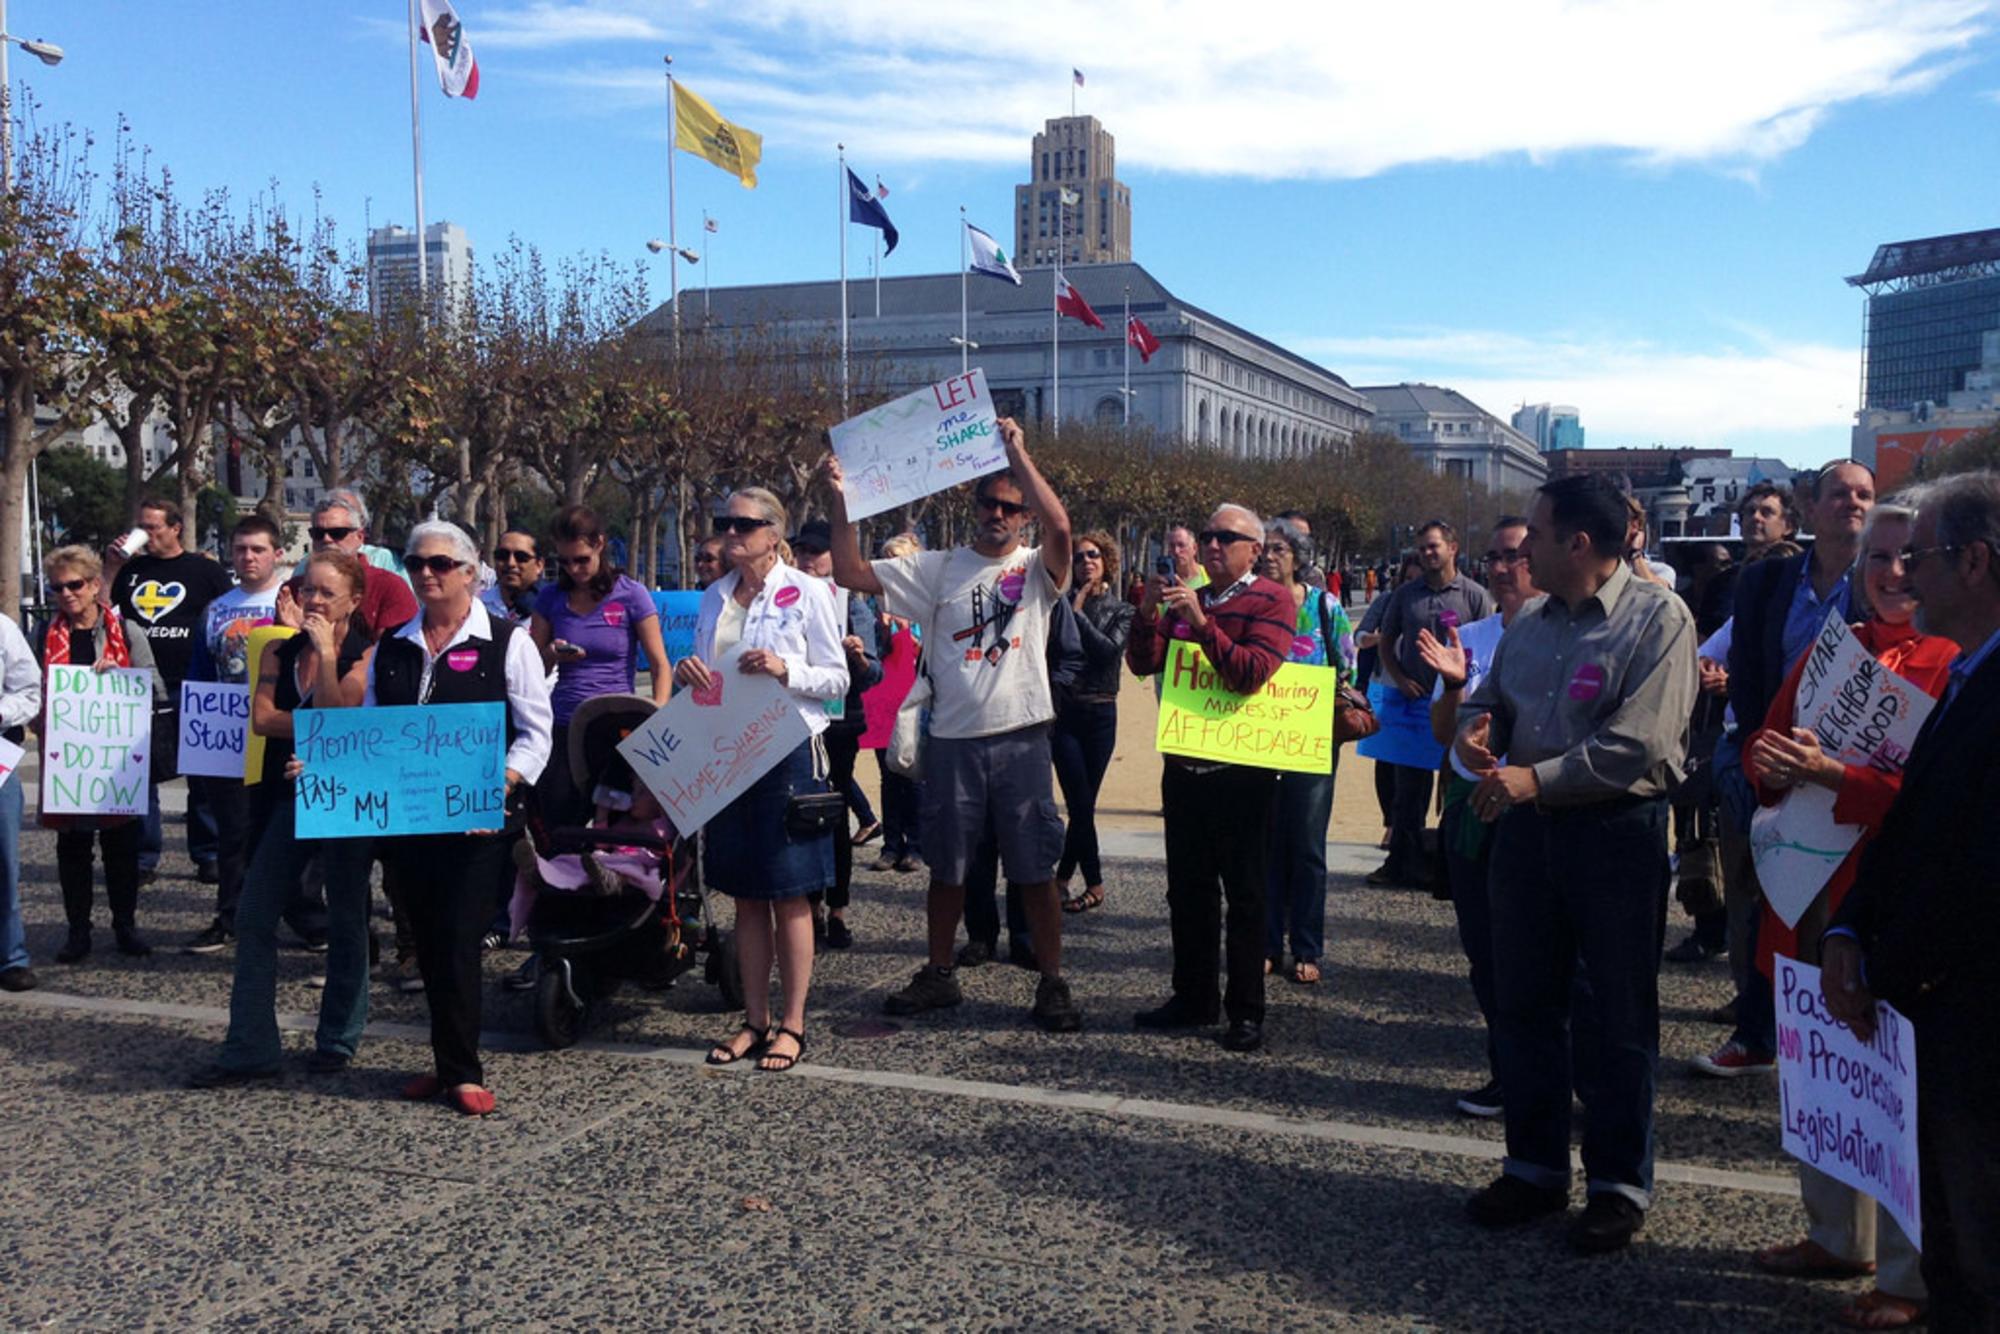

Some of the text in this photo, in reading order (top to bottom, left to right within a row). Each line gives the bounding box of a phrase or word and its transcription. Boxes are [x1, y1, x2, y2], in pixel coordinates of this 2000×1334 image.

[932, 371, 977, 411] LET
[936, 417, 993, 451] SHARE
[937, 411, 977, 433] me
[1801, 619, 1846, 710] SHARE
[54, 668, 147, 697] DO THIS
[1266, 680, 1319, 711] haring
[53, 697, 142, 738] RIGHT
[1204, 697, 1293, 721] MAKES SF
[1814, 659, 1882, 751] NEIGHBOR
[1161, 709, 1330, 760] AFFORDABLE
[1852, 694, 1898, 754] HOOD
[64, 742, 130, 771] DO IT
[634, 727, 682, 767] WE
[52, 774, 143, 807] NOW
[444, 784, 504, 817] BILLS
